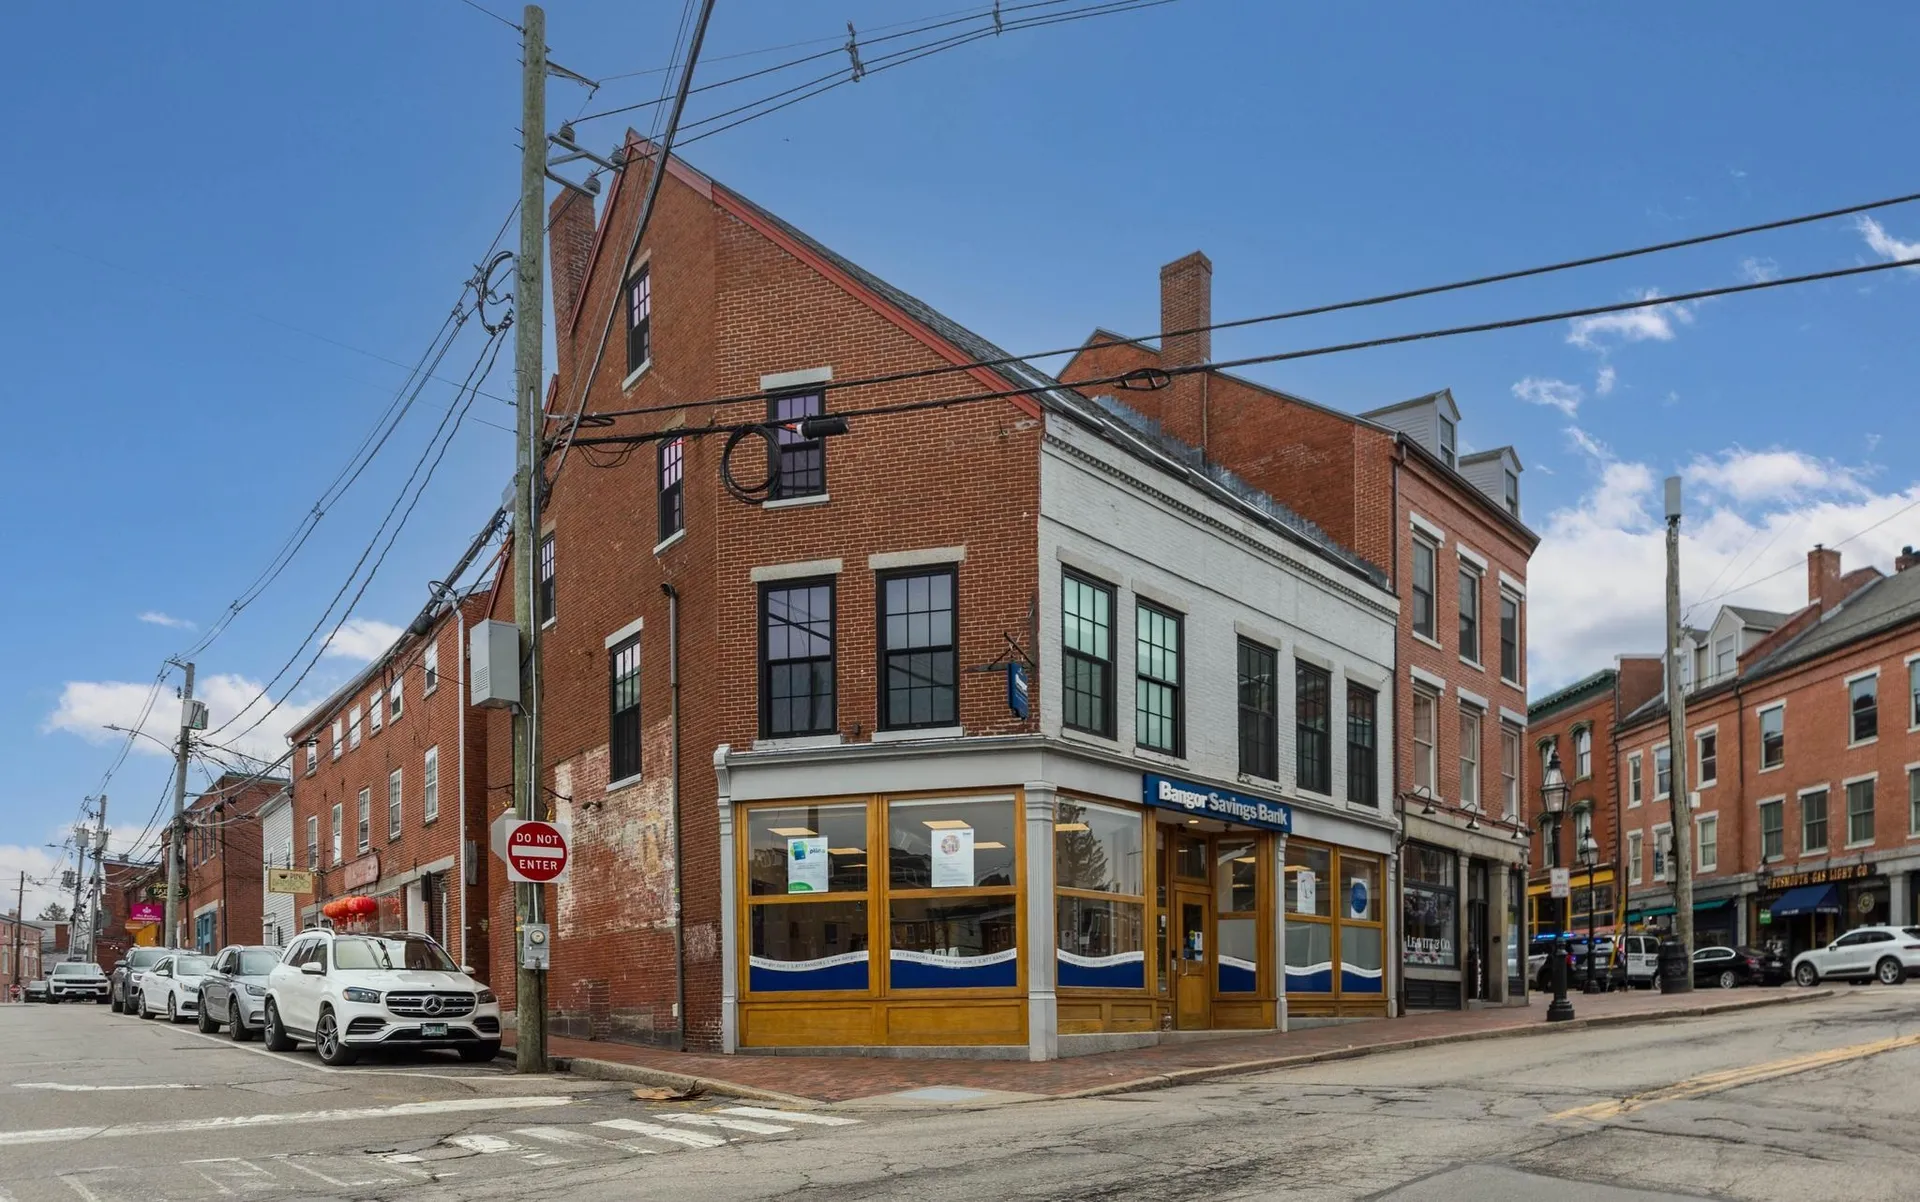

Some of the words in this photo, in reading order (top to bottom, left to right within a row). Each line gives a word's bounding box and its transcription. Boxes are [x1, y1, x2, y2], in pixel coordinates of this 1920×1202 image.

[1159, 780, 1208, 809] Bangor
[1208, 792, 1258, 820] Savings
[1257, 803, 1288, 825] Bank
[516, 833, 532, 843] DO
[537, 834, 559, 845] NOT
[519, 859, 558, 870] ENTER
[1812, 870, 1827, 883] GAS
[1829, 866, 1853, 880] LIGHT
